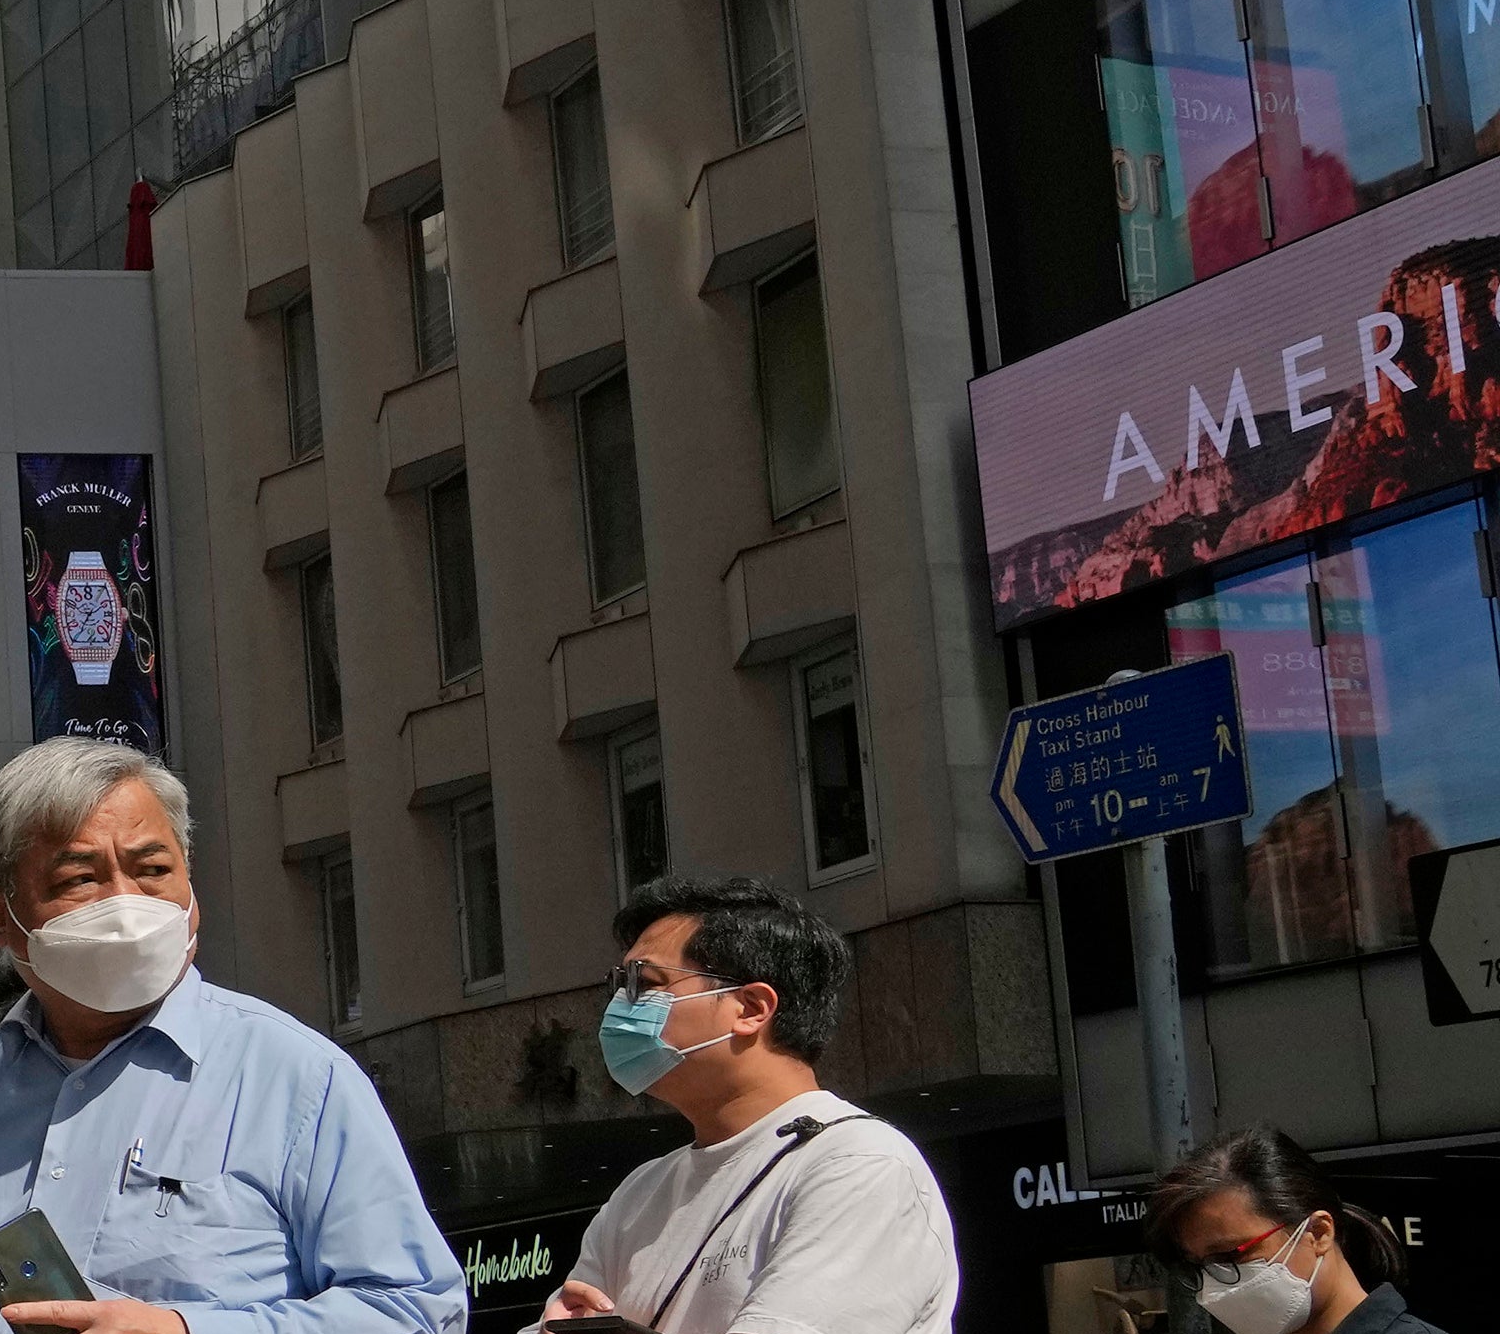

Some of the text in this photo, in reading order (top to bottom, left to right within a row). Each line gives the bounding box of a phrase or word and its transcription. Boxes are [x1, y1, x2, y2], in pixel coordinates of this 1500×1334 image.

[1102, 280, 1500, 504] AMERI
[35, 482, 132, 508] FRANCK MULLER
[65, 718, 129, 735] Time To Go
[1037, 695, 1149, 735] Cross Harbour
[1039, 722, 1122, 758] Taxi Stand
[1044, 743, 1157, 793] 過海的士站
[1159, 772, 1179, 786] am
[1193, 767, 1211, 802] 7
[1055, 799, 1074, 813] pm
[465, 1233, 553, 1298] Homebake
